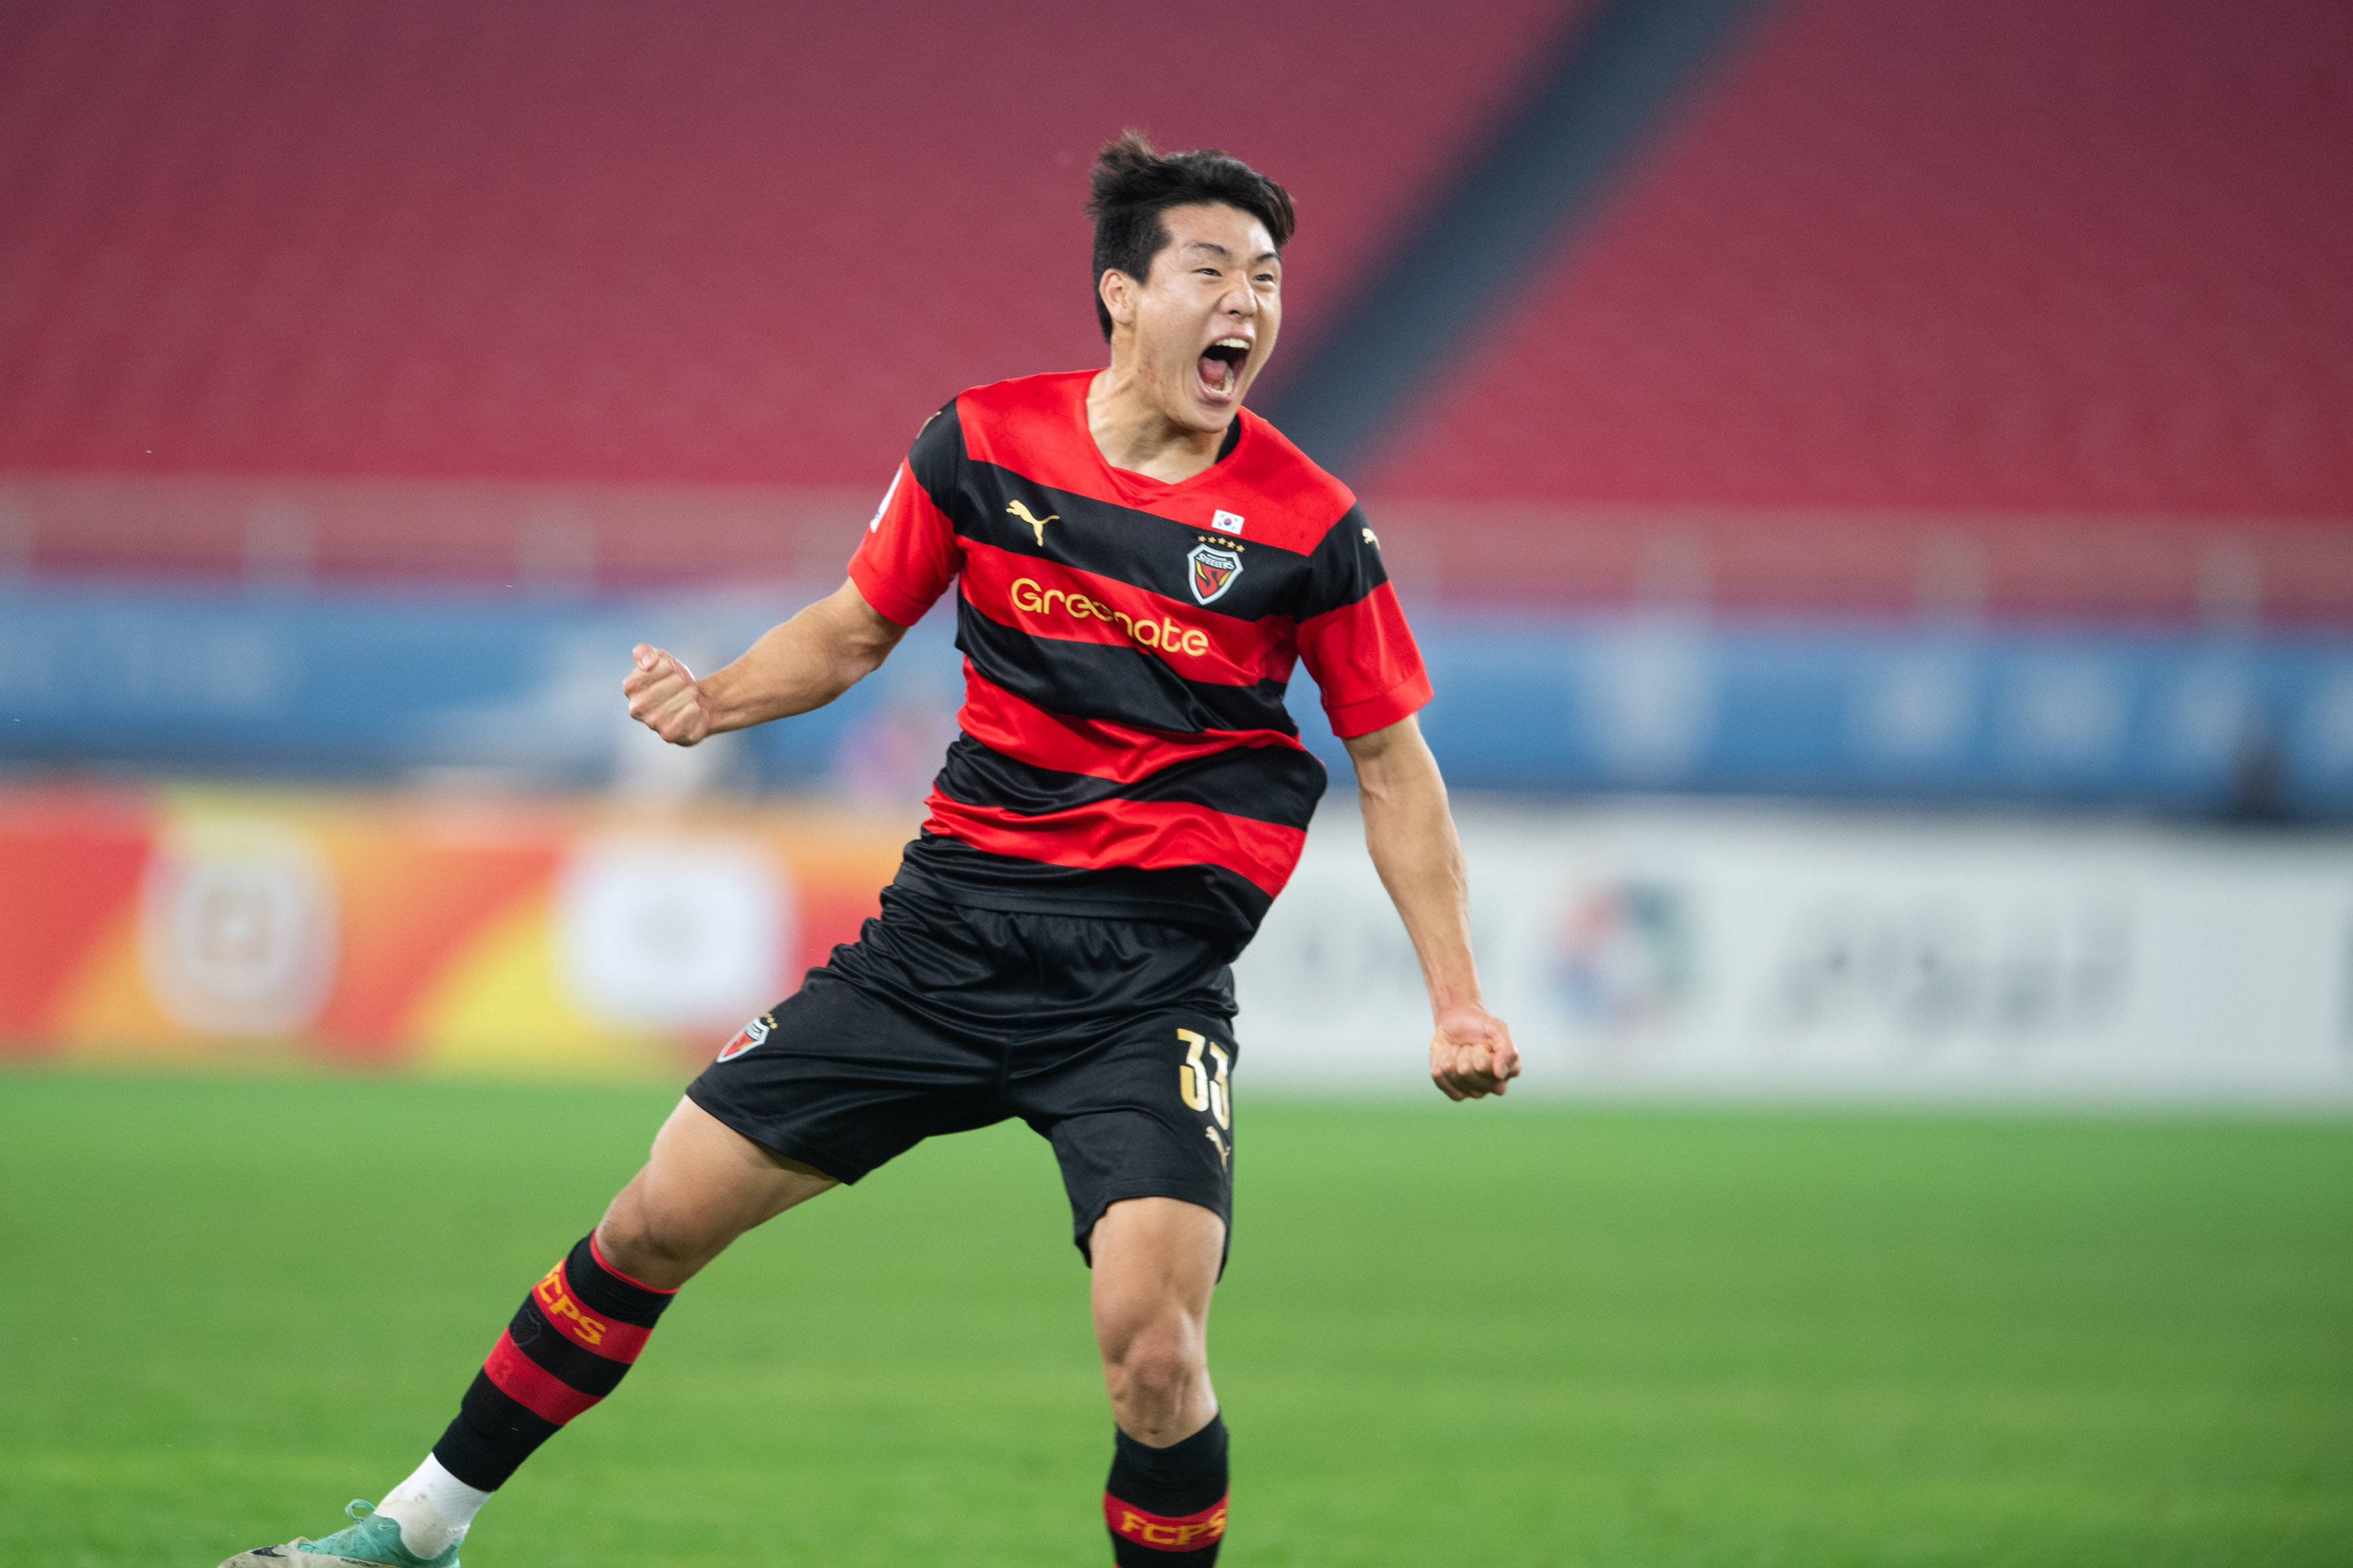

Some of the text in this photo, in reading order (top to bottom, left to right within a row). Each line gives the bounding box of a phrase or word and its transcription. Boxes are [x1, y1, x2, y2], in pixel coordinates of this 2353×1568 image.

[1011, 578, 1209, 656] Greenate
[1176, 1028, 1230, 1130] 33
[1120, 1509, 1226, 1545] FCPS
